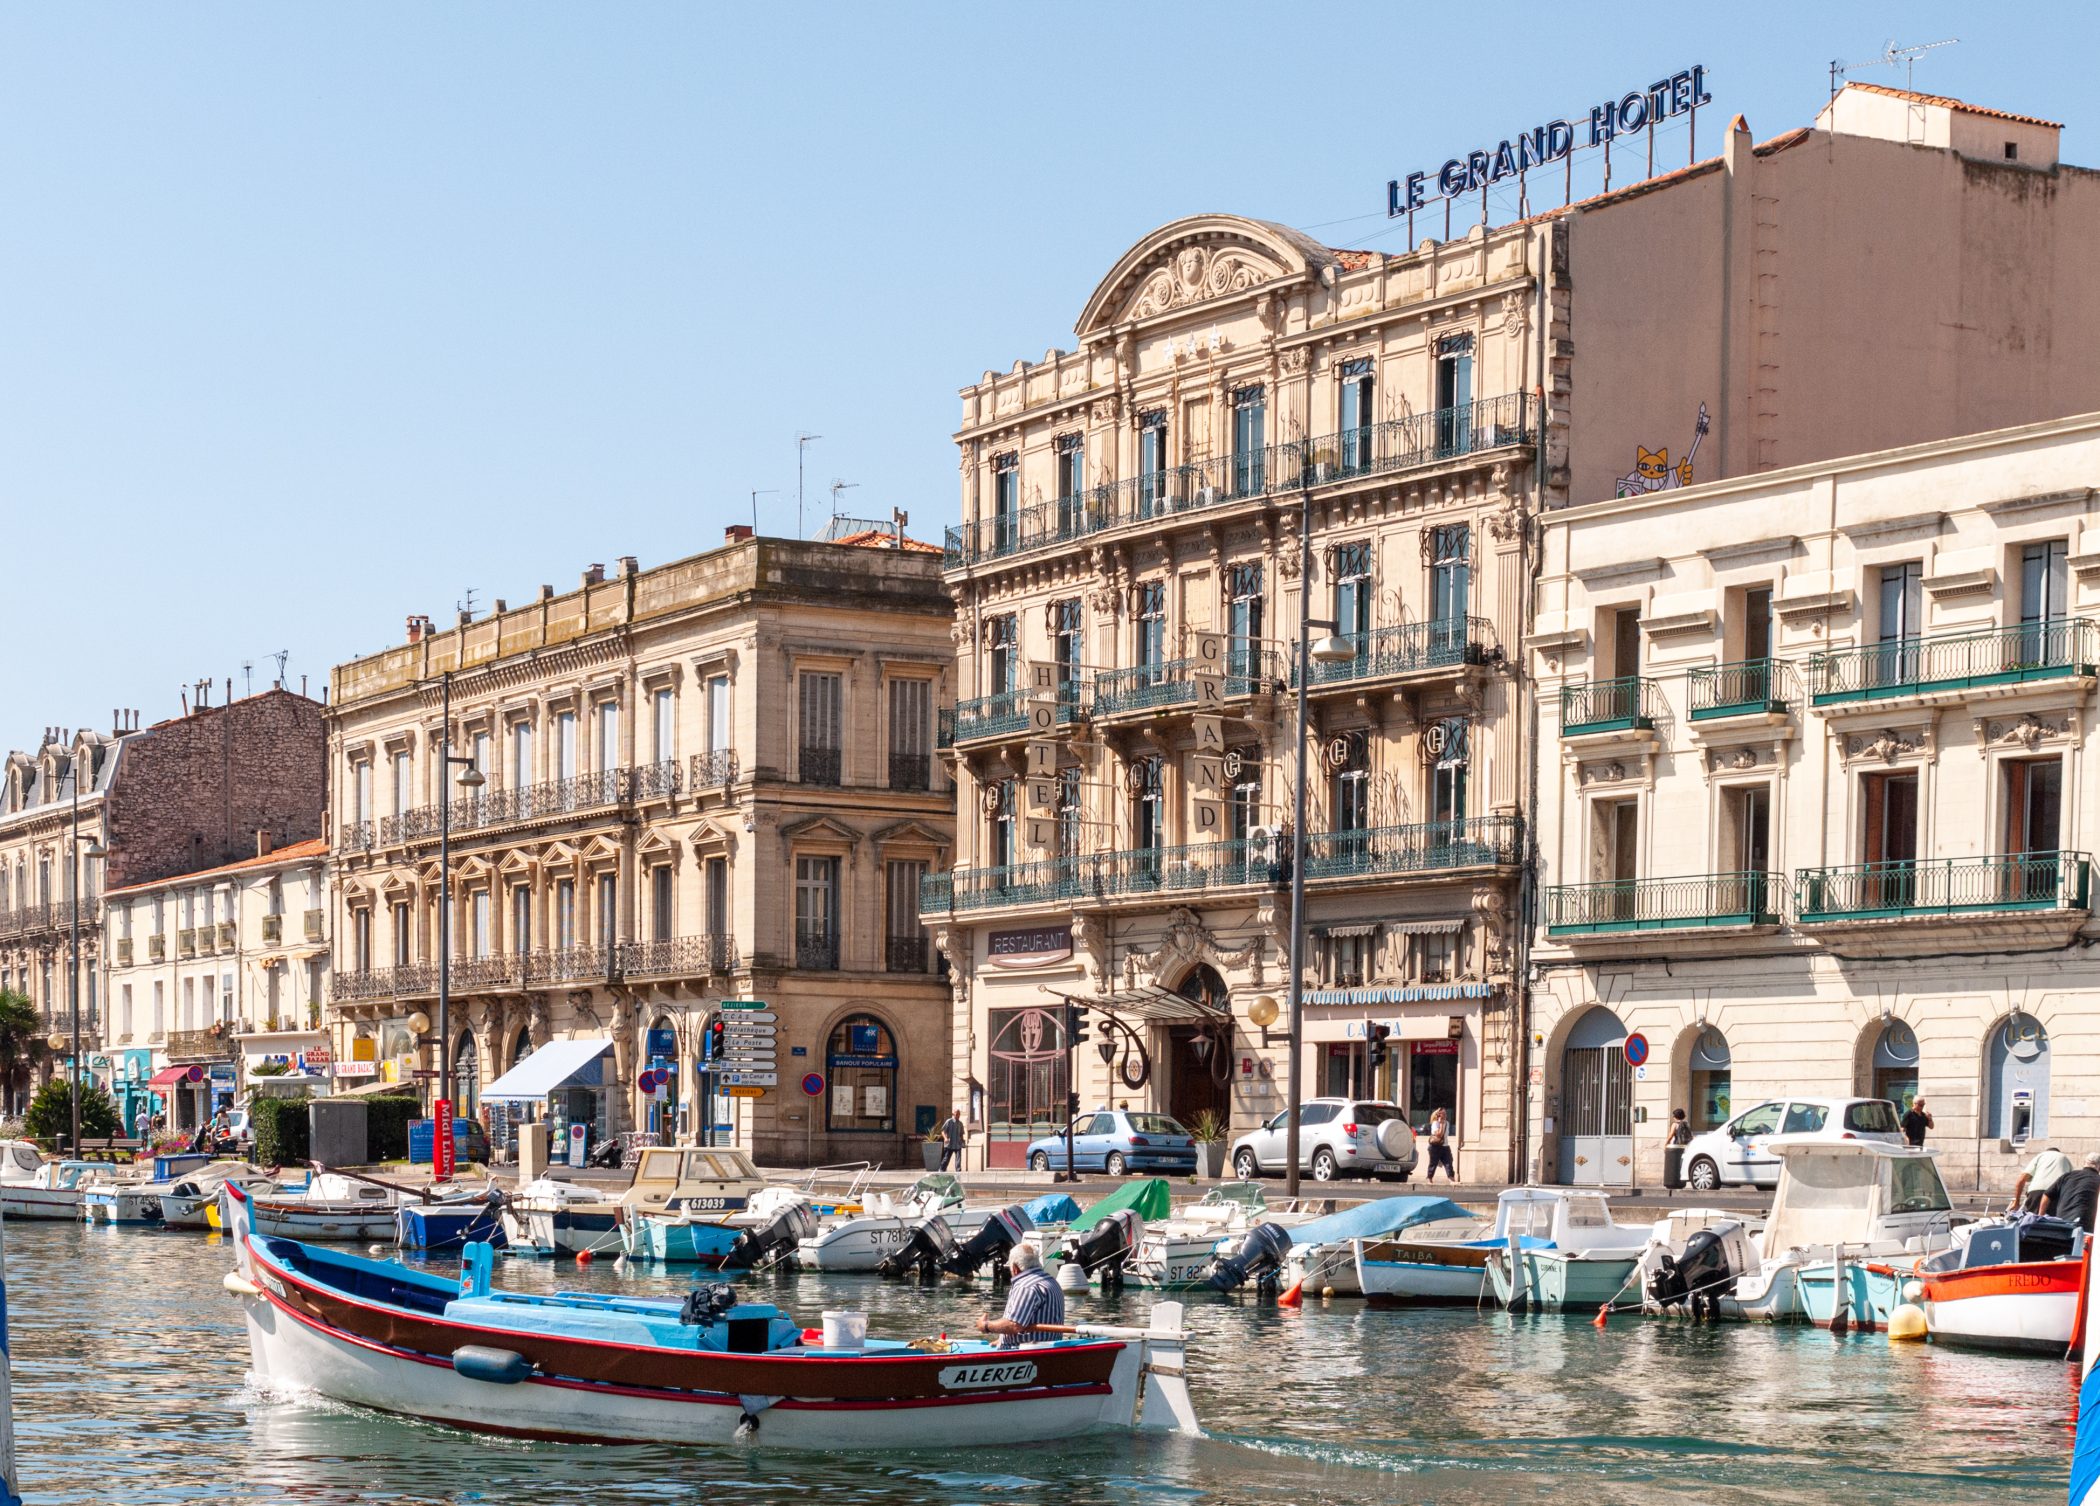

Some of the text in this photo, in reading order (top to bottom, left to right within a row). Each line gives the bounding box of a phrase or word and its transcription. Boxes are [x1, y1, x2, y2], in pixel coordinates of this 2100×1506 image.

[1387, 64, 1712, 219] LE GRAND HOTEL
[1200, 639, 1219, 827] GRAND
[1033, 667, 1052, 844] HOTEL
[994, 933, 1064, 953] RESTAURANT
[1346, 1021, 1402, 1038] CAA
[2007, 1025, 2048, 1042] LCL
[341, 1064, 357, 1074] GRAND
[441, 1104, 450, 1178] Midi Libre
[691, 1198, 726, 1209] 613039
[871, 1231, 884, 1244] ST
[1395, 1248, 1433, 1260] TAIBA
[1170, 1266, 1184, 1280] ST
[2008, 1273, 2052, 1287] FREDO
